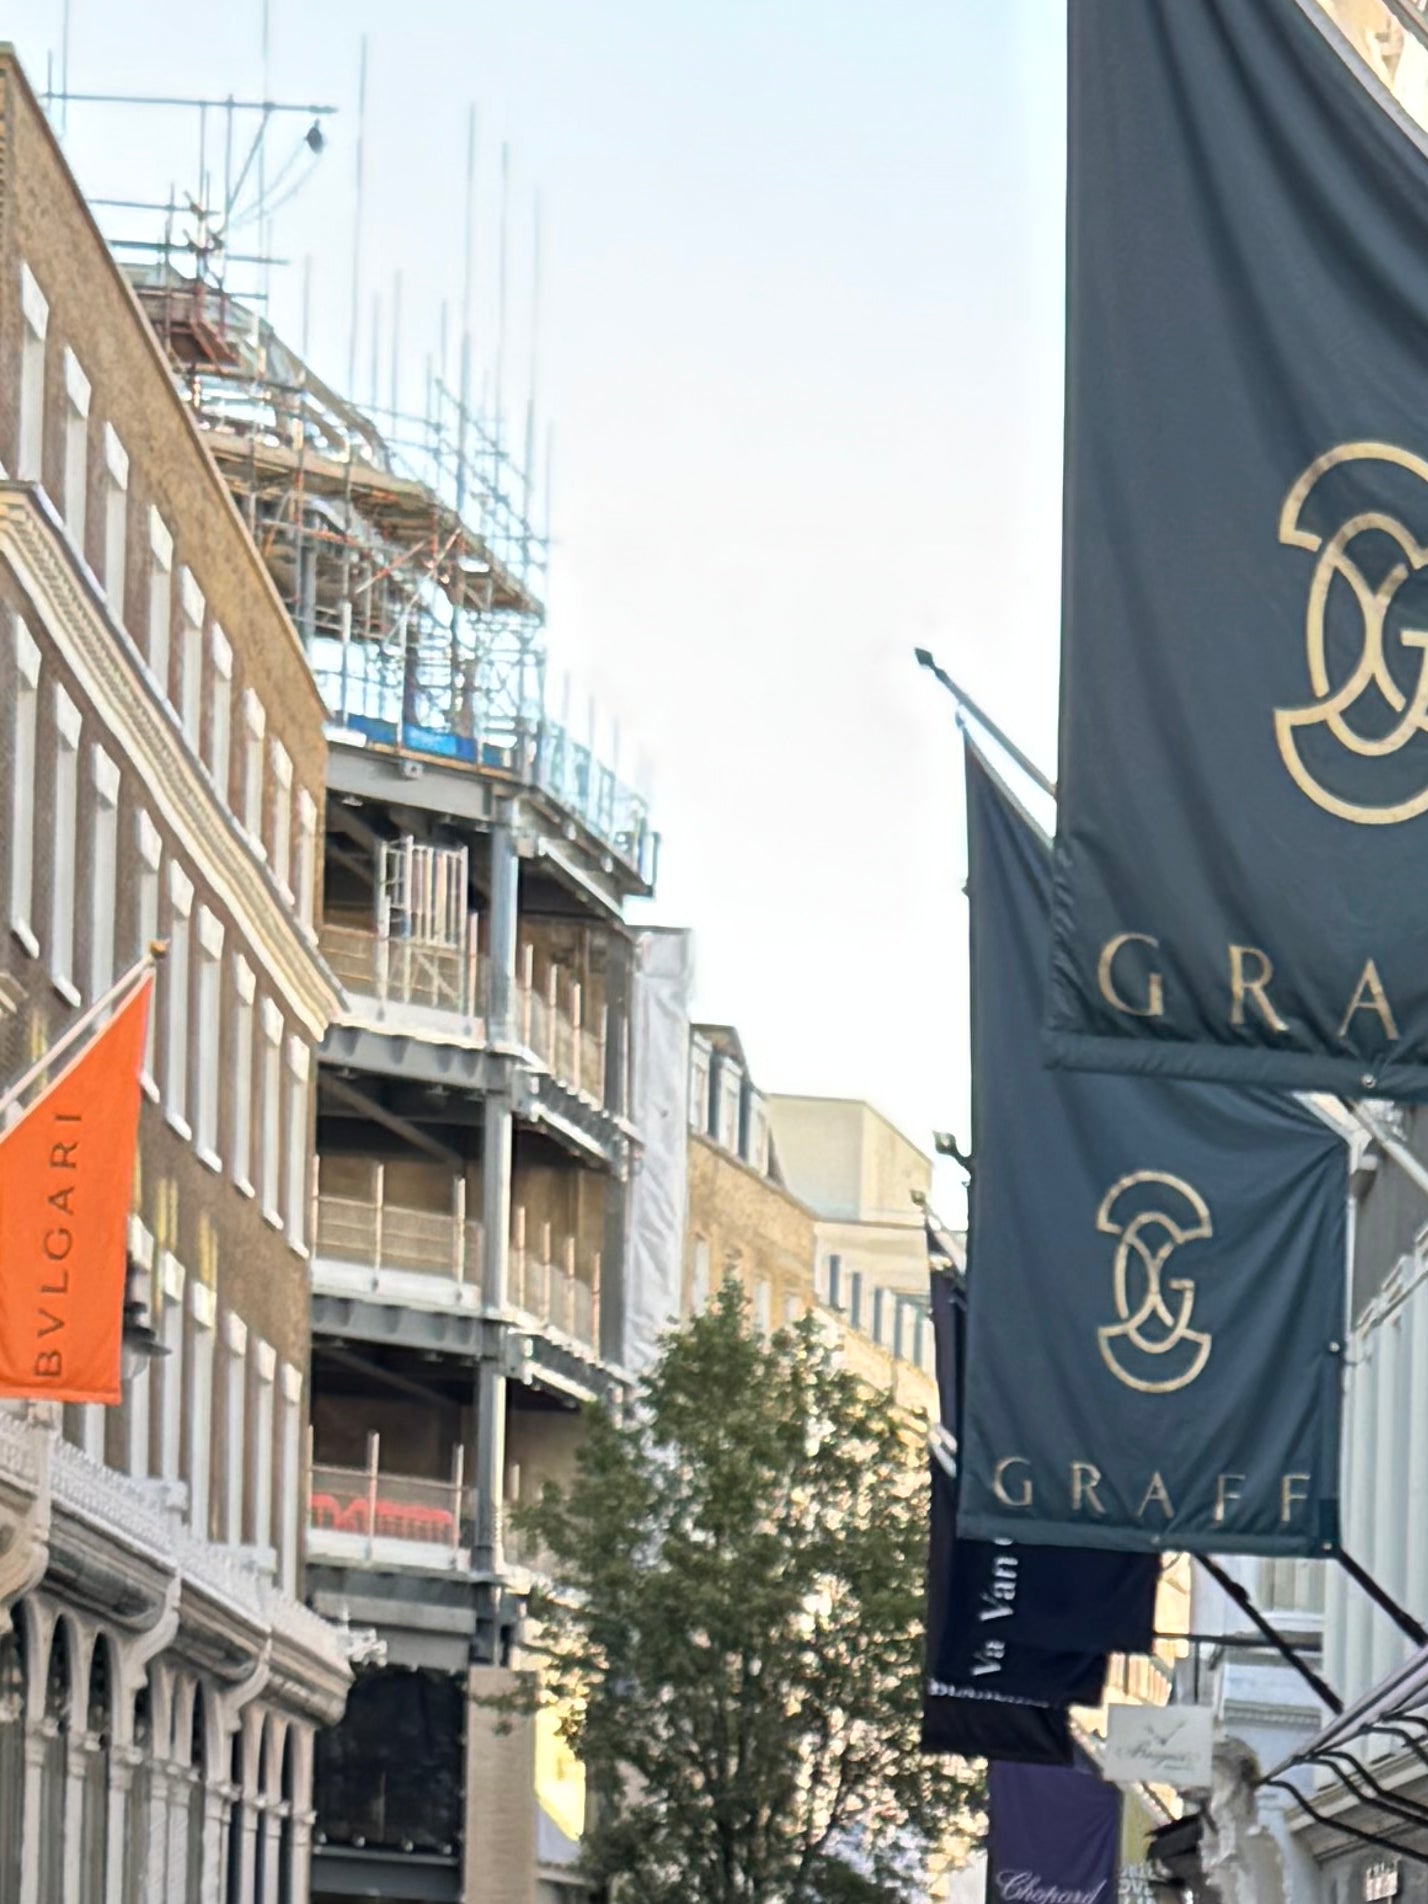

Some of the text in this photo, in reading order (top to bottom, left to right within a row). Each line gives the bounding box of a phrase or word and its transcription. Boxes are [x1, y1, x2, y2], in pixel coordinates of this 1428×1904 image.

[34, 1111, 83, 1379] BVLGARI
[993, 1457, 1311, 1523] GRAFF
[979, 1556, 1018, 1621] Van
